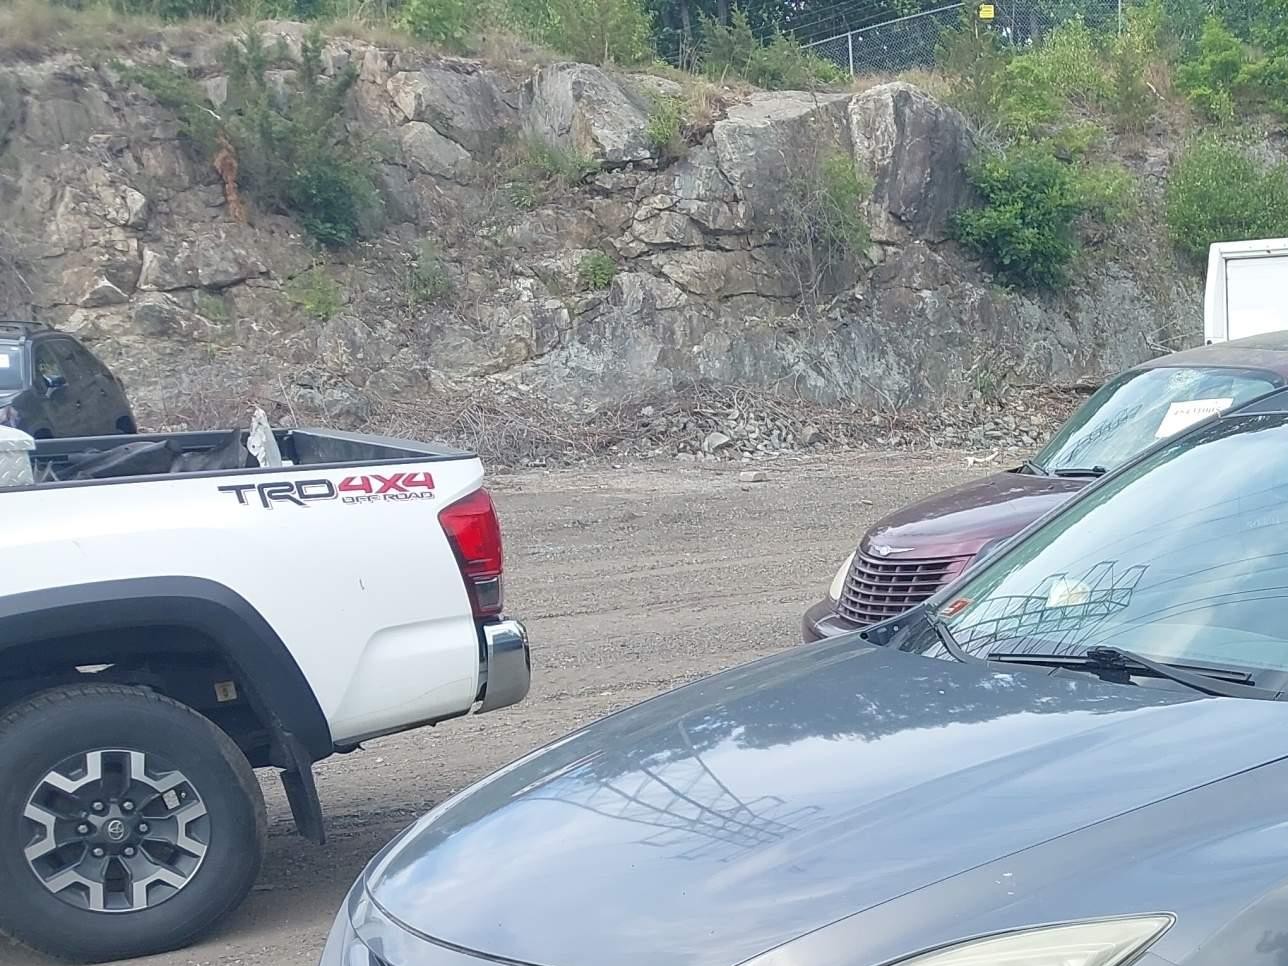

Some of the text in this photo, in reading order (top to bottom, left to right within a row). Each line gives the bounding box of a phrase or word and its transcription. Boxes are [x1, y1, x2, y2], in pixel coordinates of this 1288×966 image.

[217, 479, 339, 510] TRD
[342, 490, 434, 505] OFF ROAD
